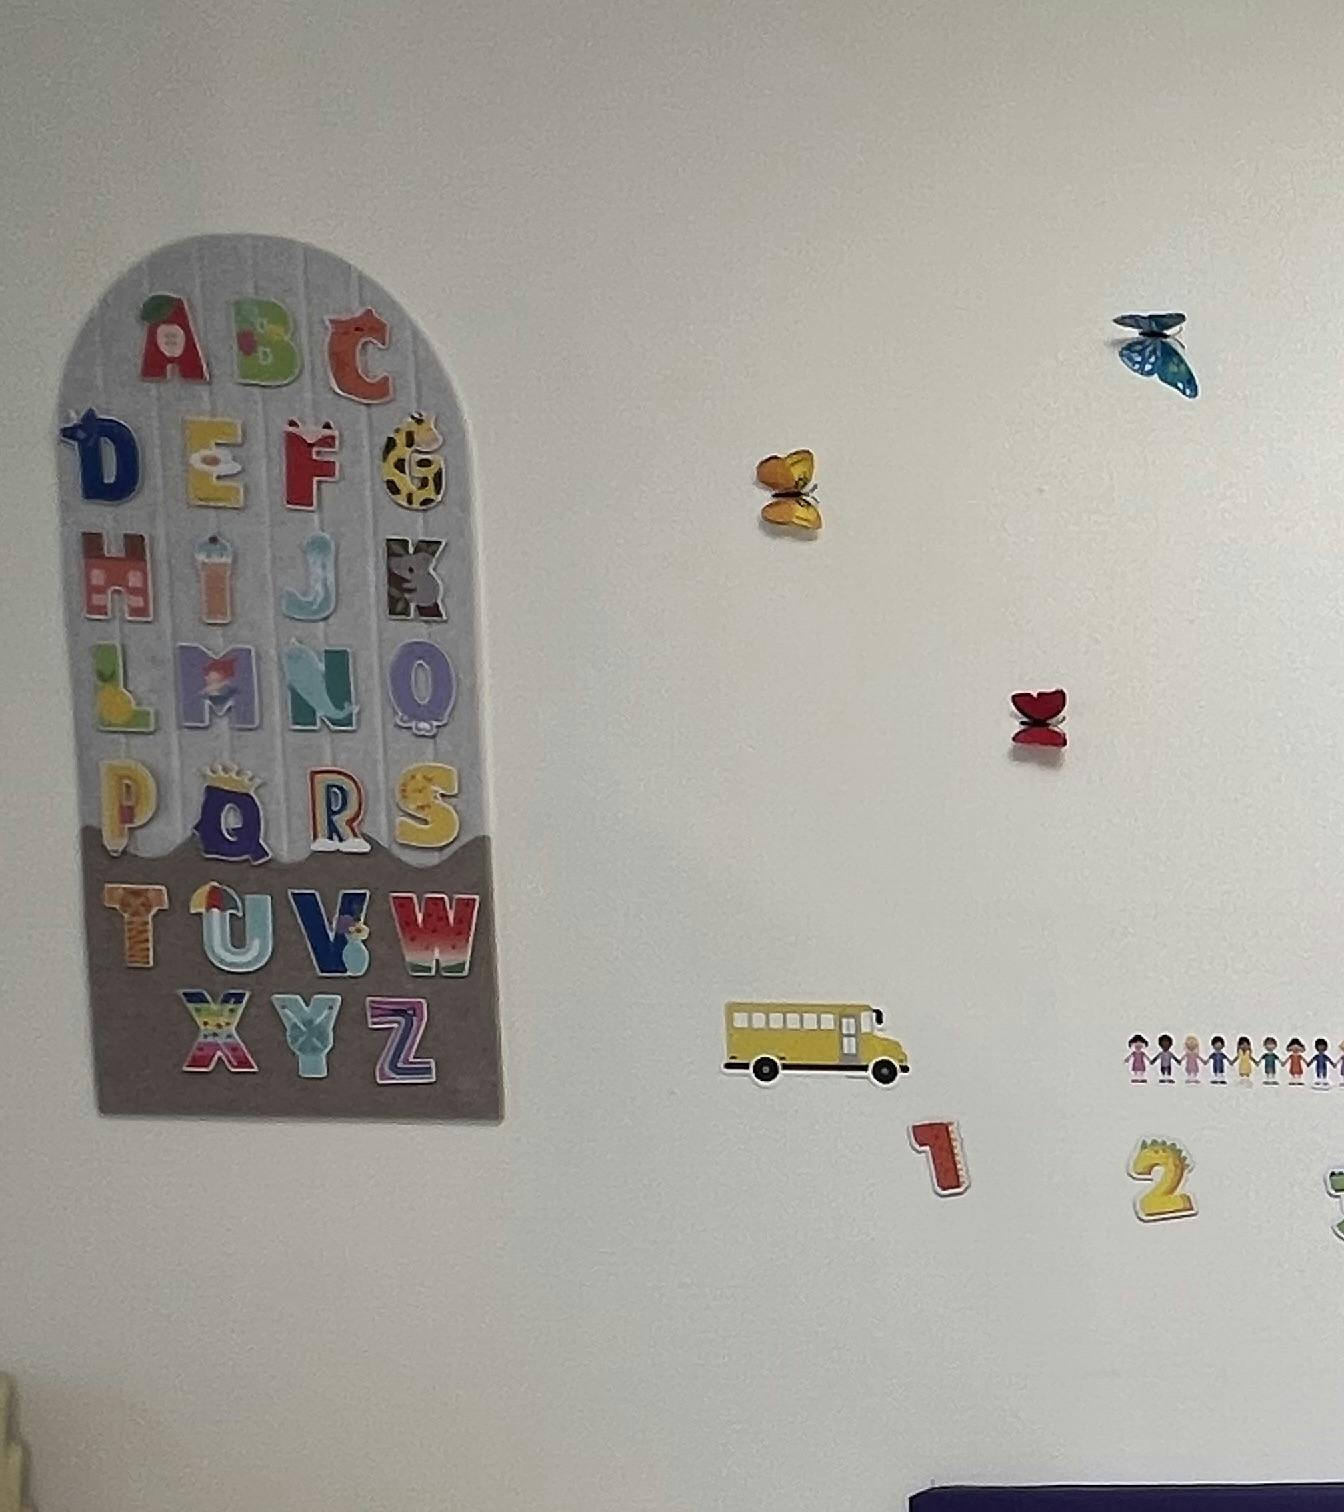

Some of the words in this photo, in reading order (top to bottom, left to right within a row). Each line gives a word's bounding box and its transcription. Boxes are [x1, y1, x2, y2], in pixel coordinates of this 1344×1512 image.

[140, 293, 209, 381] A
[232, 297, 303, 386] B
[324, 308, 394, 403] C
[60, 408, 141, 506] D
[182, 418, 245, 508] E
[283, 418, 340, 511] F
[382, 410, 445, 511] G
[82, 532, 153, 622] H
[195, 534, 234, 624] I
[281, 532, 337, 622] J
[386, 537, 447, 622] K
[95, 642, 155, 733] L
[177, 644, 259, 729] M
[281, 639, 359, 731] N
[389, 640, 456, 736] O
[100, 758, 157, 856] P
[194, 761, 271, 865] Q
[308, 767, 372, 854] R
[394, 763, 460, 848] S
[105, 884, 168, 969] T
[190, 881, 273, 973] U
[288, 889, 370, 977] V
[389, 893, 480, 977] W
[178, 990, 259, 1072] X
[271, 995, 341, 1078] Y
[365, 997, 436, 1085] Z
[911, 1119, 969, 1194] 1
[1130, 1138, 1195, 1221] 2
